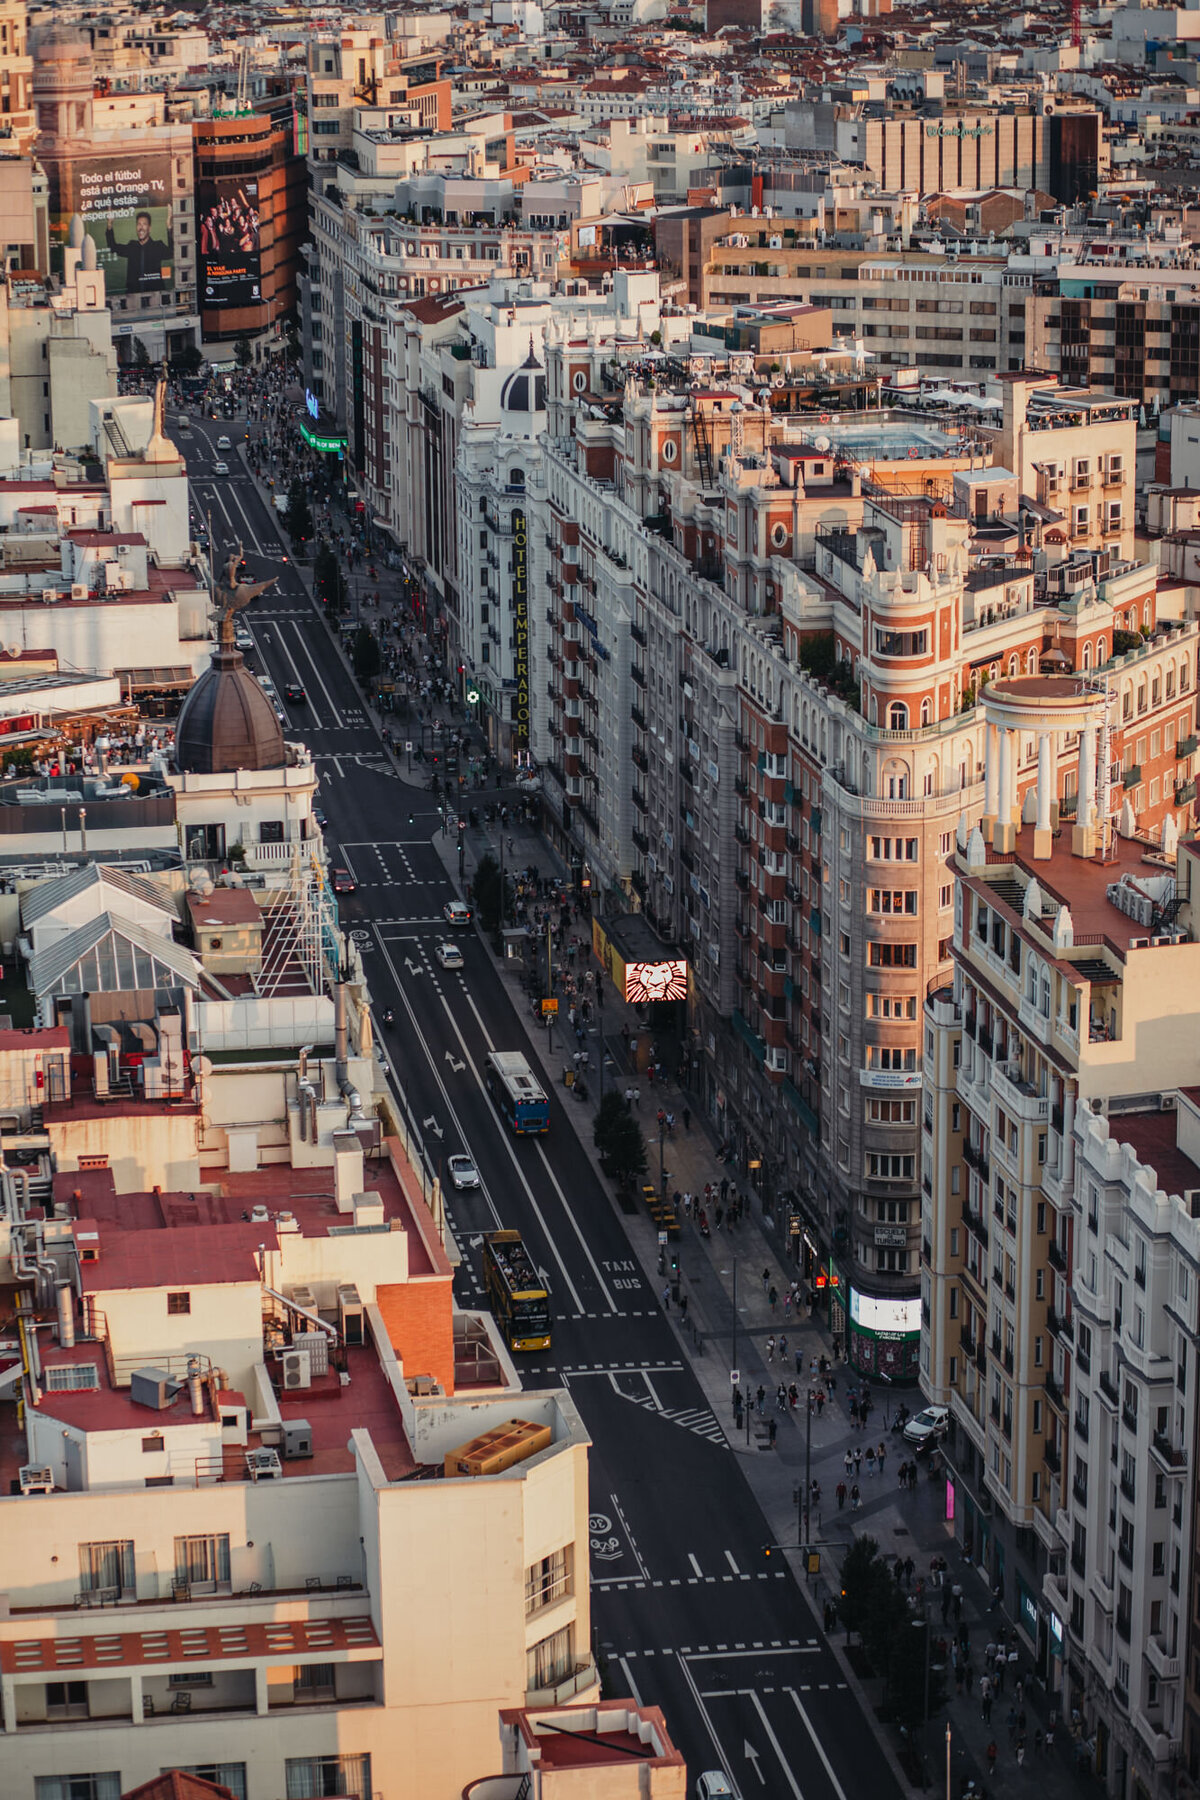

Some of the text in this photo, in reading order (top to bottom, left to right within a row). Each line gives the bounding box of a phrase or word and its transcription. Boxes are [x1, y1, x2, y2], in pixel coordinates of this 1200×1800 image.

[80, 168, 141, 184] Todo el fútbol
[80, 180, 165, 196] está en Orange TV,
[81, 194, 138, 211] ¿a qué estás
[81, 207, 135, 222] esperando?
[515, 517, 529, 736] HOTEL EMPERADOR
[875, 1228, 905, 1236] ESCUELA
[602, 1260, 635, 1272] TAXI
[613, 1278, 642, 1289] BUS
